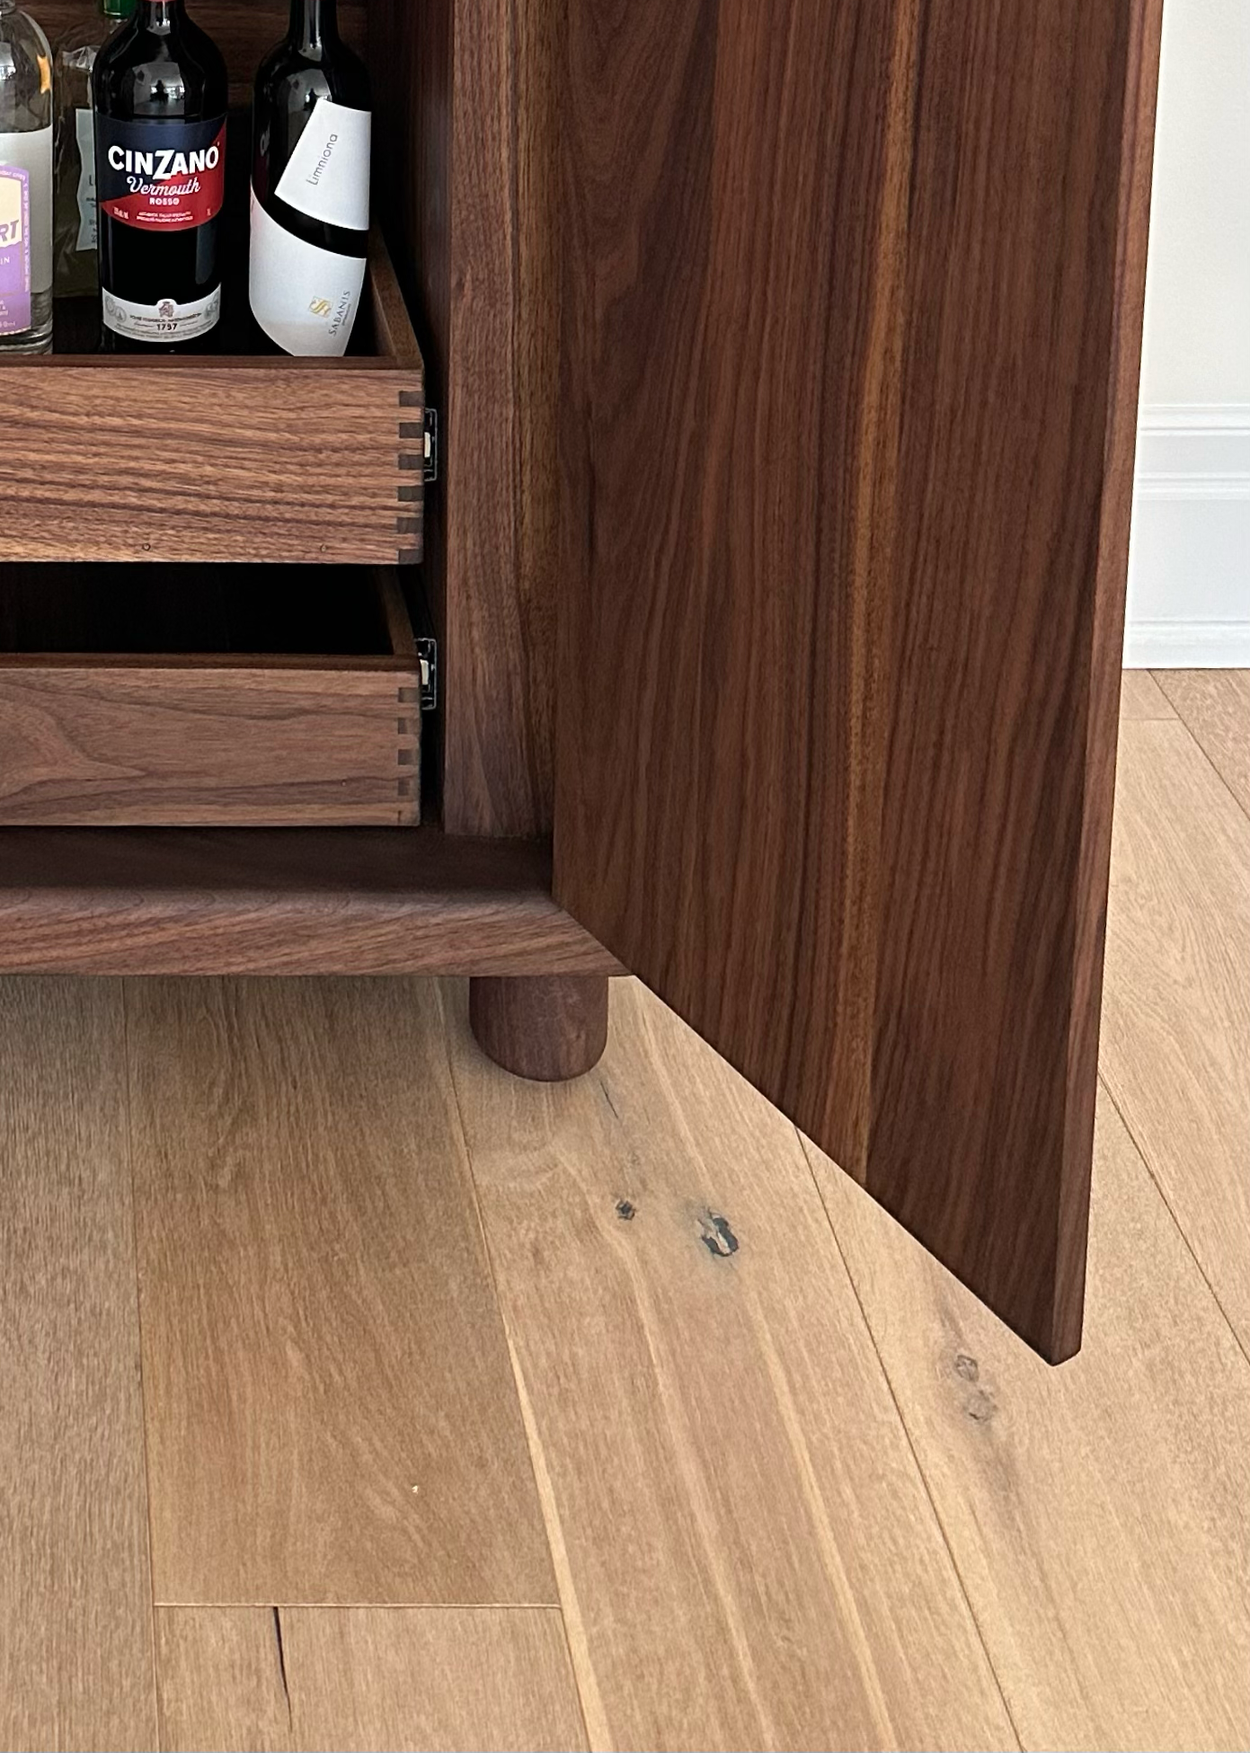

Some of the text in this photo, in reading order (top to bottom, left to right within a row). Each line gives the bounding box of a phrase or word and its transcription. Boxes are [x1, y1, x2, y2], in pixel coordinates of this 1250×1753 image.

[108, 145, 219, 180] CINZANO
[306, 133, 338, 186] Limniona
[126, 176, 201, 196] Vermouth
[150, 197, 180, 205] ROSSO
[328, 290, 351, 338] SABANIS
